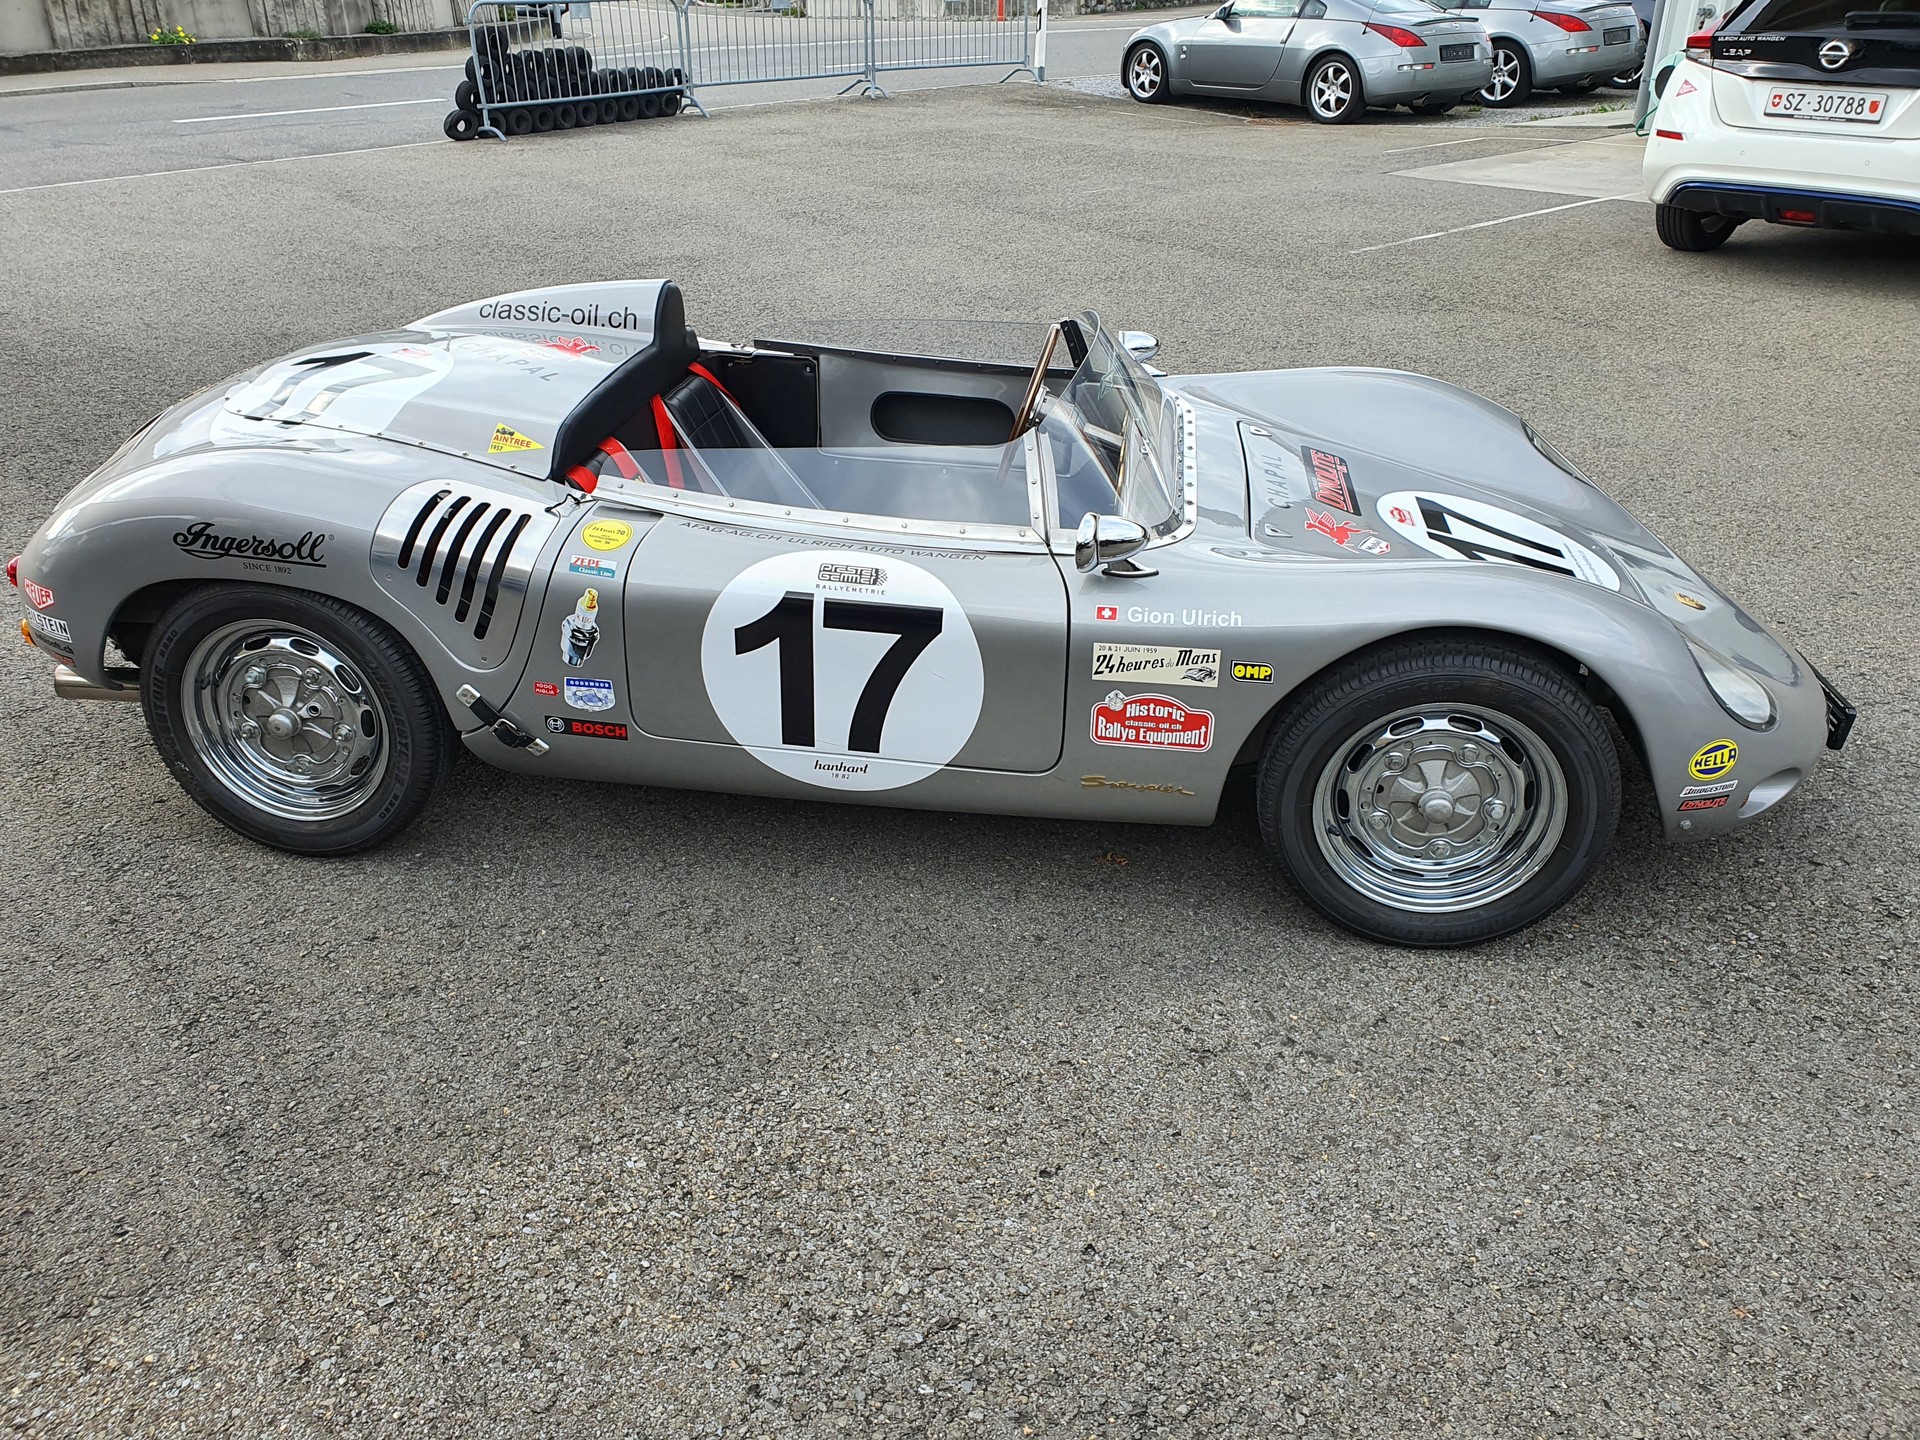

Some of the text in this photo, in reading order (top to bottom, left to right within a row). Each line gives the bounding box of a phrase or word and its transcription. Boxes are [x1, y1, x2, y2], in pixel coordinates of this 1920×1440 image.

[479, 300, 638, 330] classic-oil.ch
[490, 443, 504, 451] 1957
[493, 434, 532, 448] AINTREE
[1262, 454, 1292, 509] CHAPAL
[1310, 449, 1347, 511] DYNOLITE
[172, 521, 326, 565] Ingersoll
[787, 537, 854, 550] ULRICH
[857, 545, 905, 555] AUTO
[909, 549, 987, 561] WANGEN
[242, 561, 292, 575] SINCE 1892
[578, 567, 599, 575] Classic
[25, 578, 52, 605] HEUER
[815, 584, 886, 596] RALLYEMETRIE
[1127, 606, 1242, 627] Gion Ulrich
[1165, 657, 1174, 668] du
[1175, 649, 1217, 667] Mans
[734, 590, 944, 753] 17
[1233, 664, 1271, 679] OMP
[569, 680, 609, 688] GOODWOOD
[1126, 703, 1186, 722] Historic
[571, 721, 627, 738] BOSCH
[1097, 716, 1206, 745] Rallye Equipment
[814, 759, 869, 774] hanhart
[1694, 747, 1737, 768] HELLA
[1682, 782, 1737, 796] BRIDGESTONE
